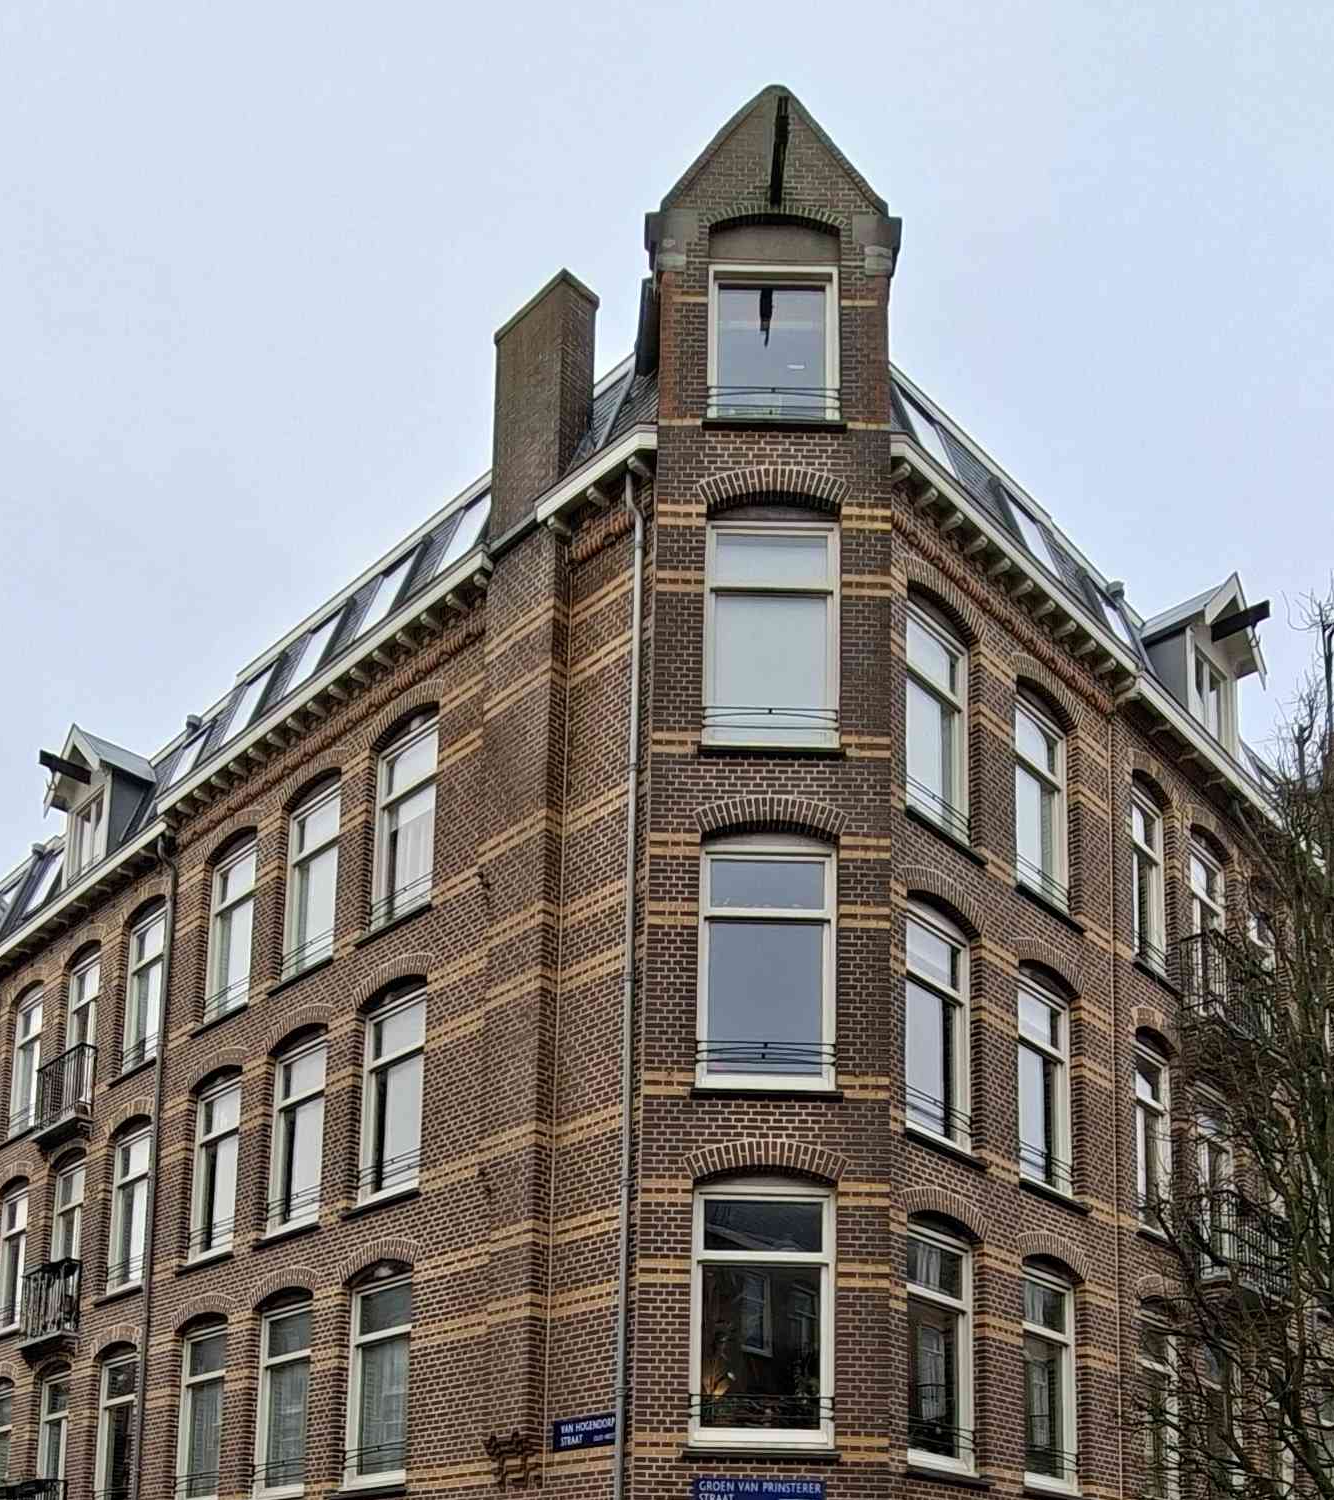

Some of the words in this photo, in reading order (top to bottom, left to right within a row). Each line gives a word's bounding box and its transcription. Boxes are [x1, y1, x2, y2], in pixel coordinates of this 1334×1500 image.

[560, 1423, 574, 1434] VAN
[560, 1434, 583, 1447] STRAAT
[698, 1480, 735, 1492] GROEN
[737, 1481, 759, 1492] VAN
[762, 1481, 822, 1494] PRINSTERER
